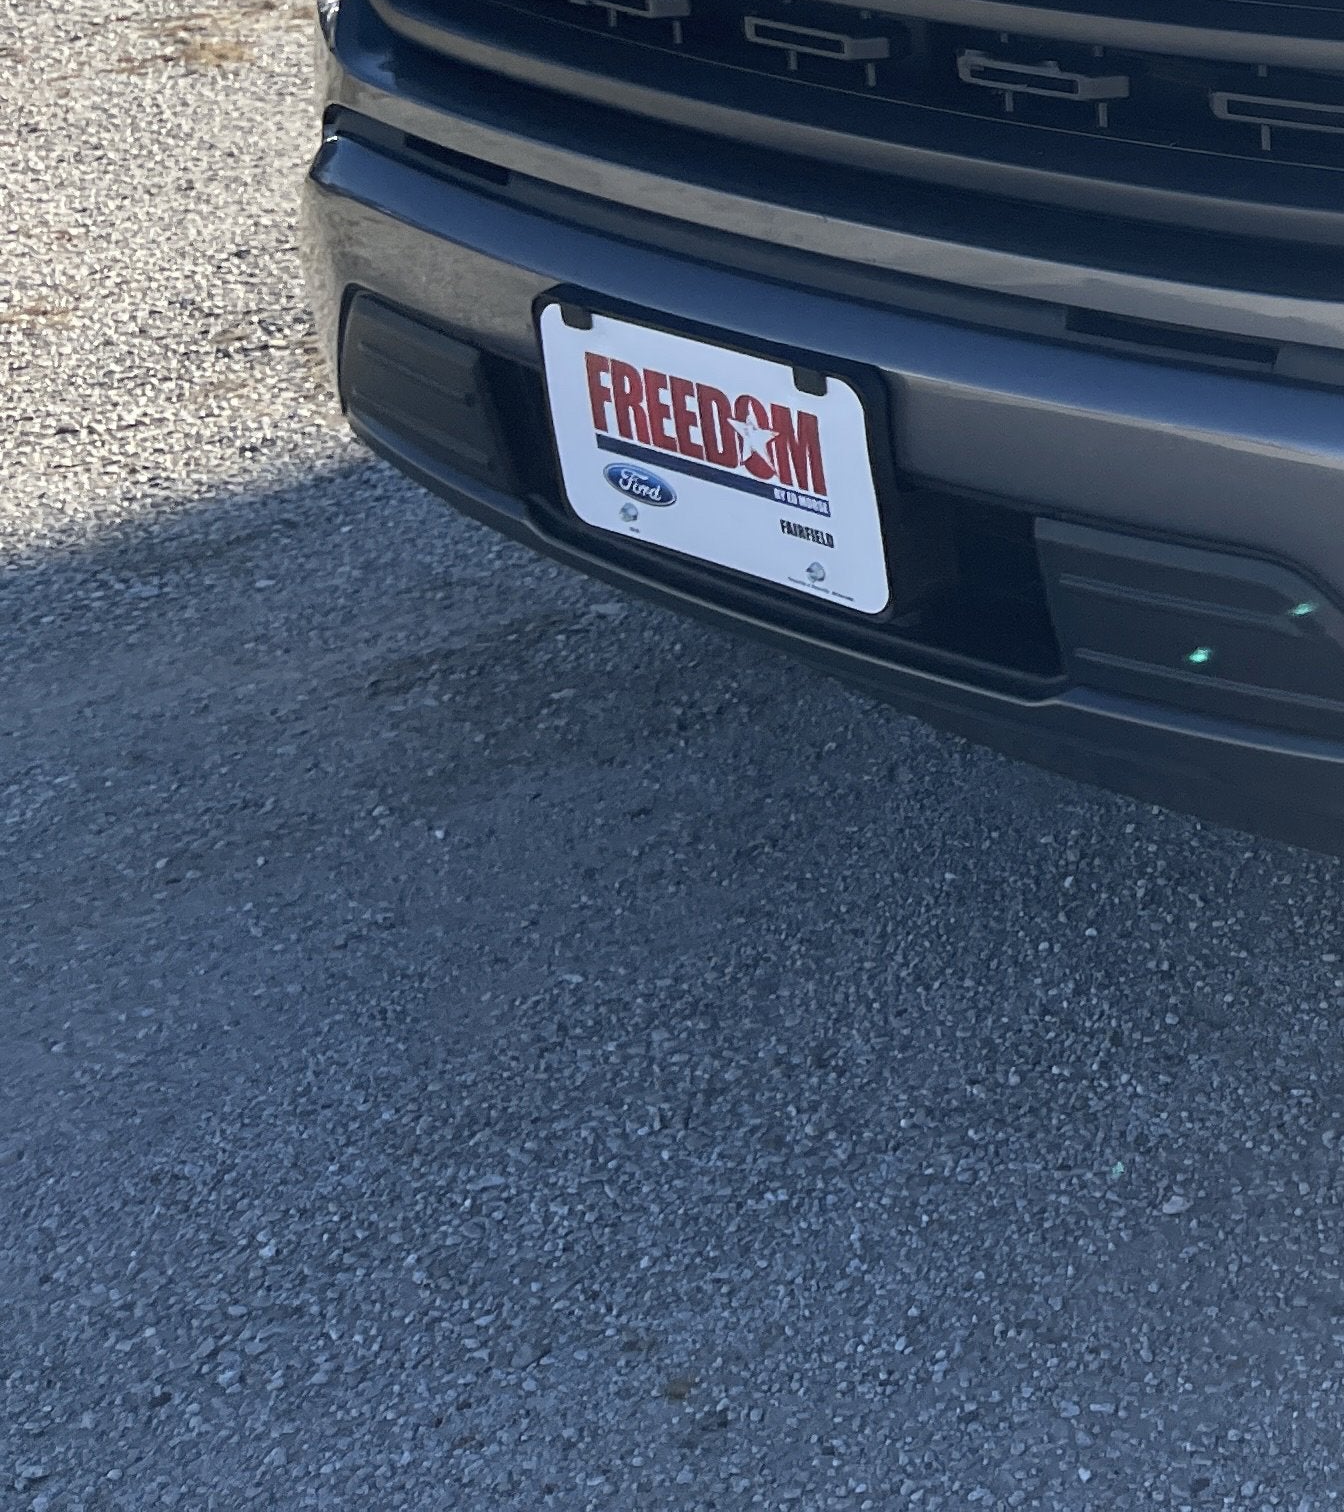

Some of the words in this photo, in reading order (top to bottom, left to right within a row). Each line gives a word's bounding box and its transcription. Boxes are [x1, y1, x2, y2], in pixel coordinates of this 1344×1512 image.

[584, 351, 828, 496] FREEDOM
[618, 469, 662, 502] Ford
[780, 518, 834, 548] FAIRFIELD
